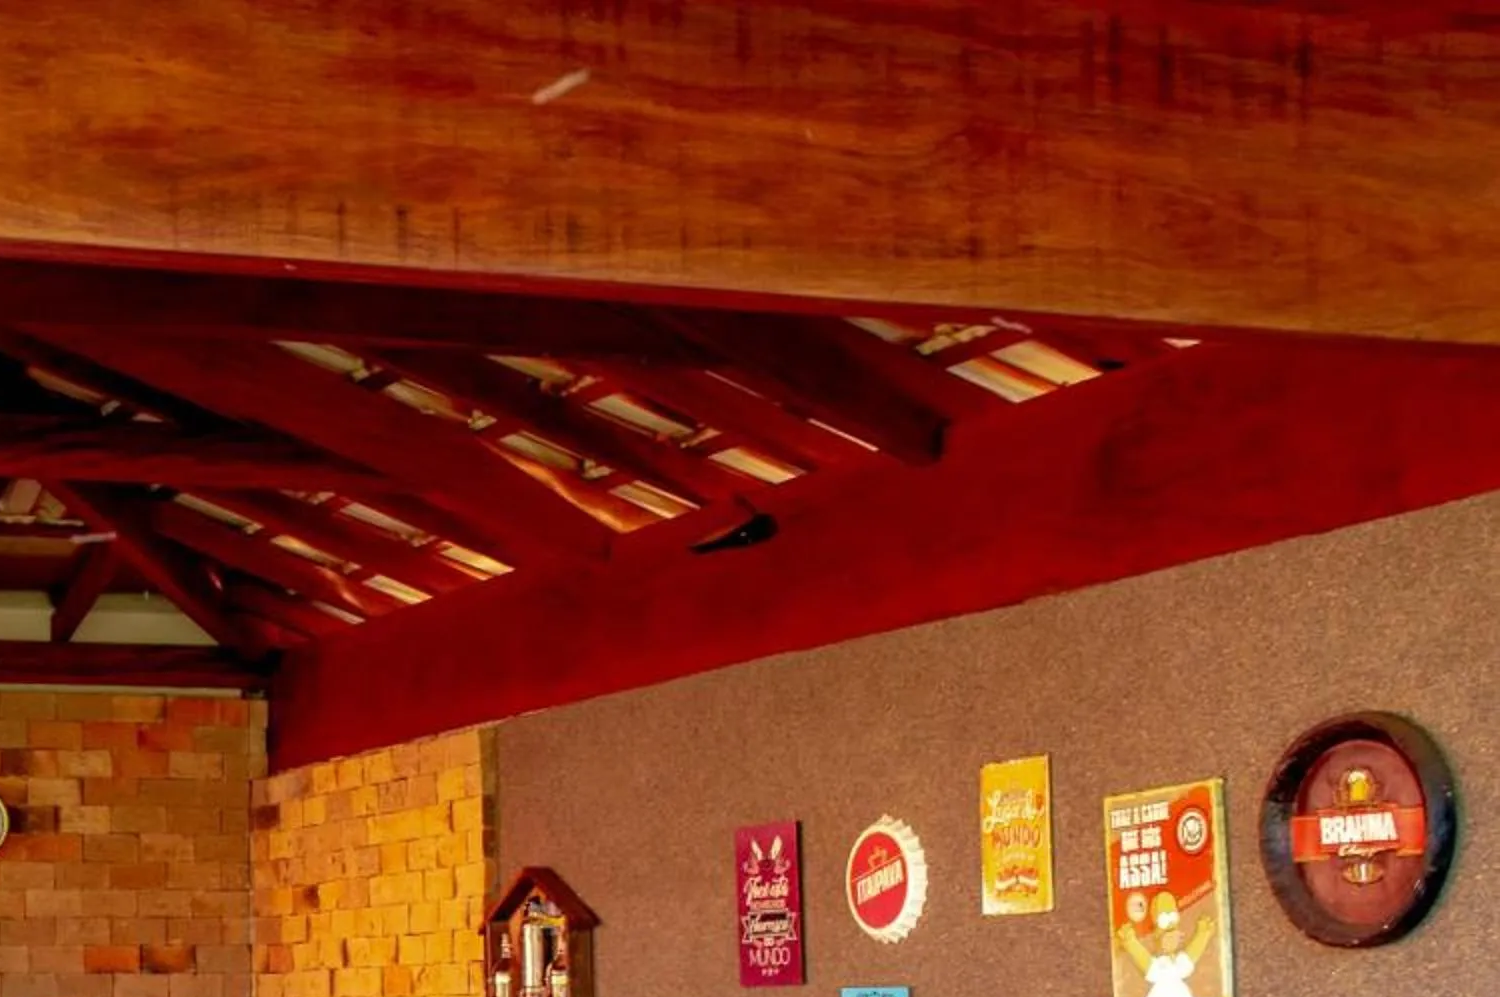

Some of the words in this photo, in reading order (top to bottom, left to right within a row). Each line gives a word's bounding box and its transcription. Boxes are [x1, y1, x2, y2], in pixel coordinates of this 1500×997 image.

[1320, 811, 1398, 845] BRAHMA
[856, 858, 904, 905] ITAIPAVA
[1119, 849, 1169, 890] ASSA!
[749, 947, 791, 967] MUNDO
